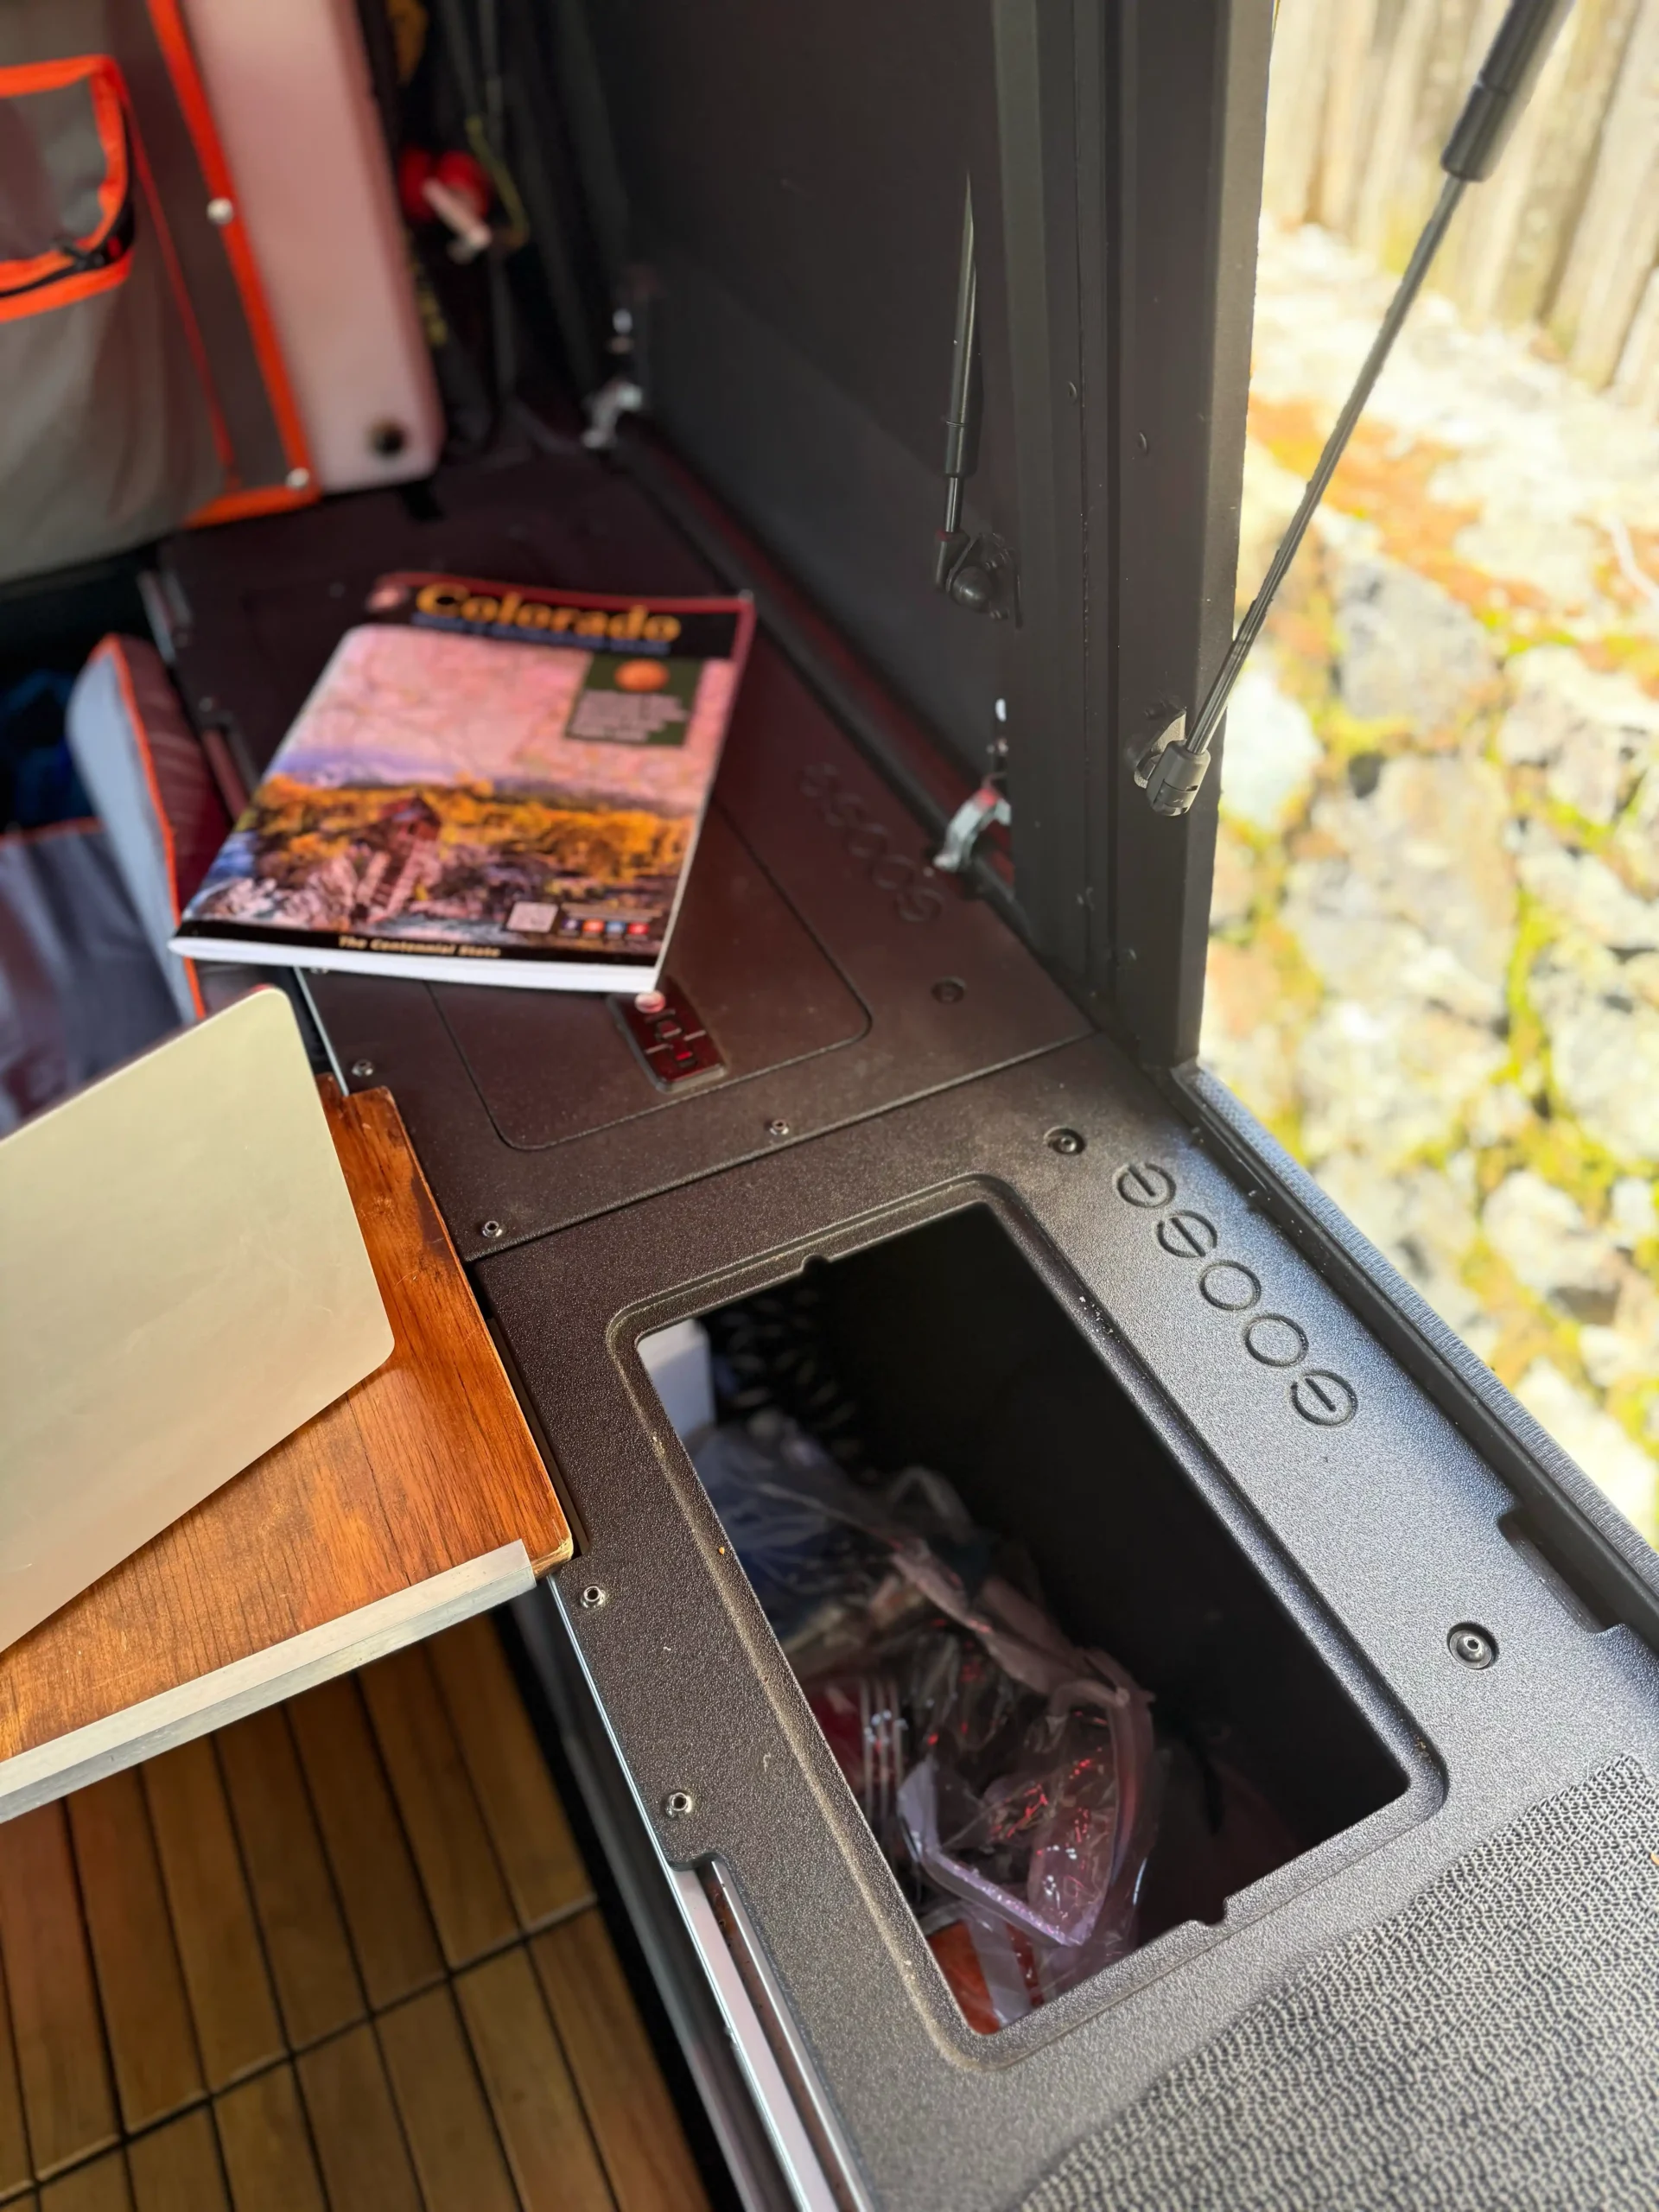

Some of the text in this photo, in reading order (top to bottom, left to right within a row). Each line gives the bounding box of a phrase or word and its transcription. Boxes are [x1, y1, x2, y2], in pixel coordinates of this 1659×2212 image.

[416, 582, 681, 643] Colorado
[338, 935, 501, 958] The Centennial State
